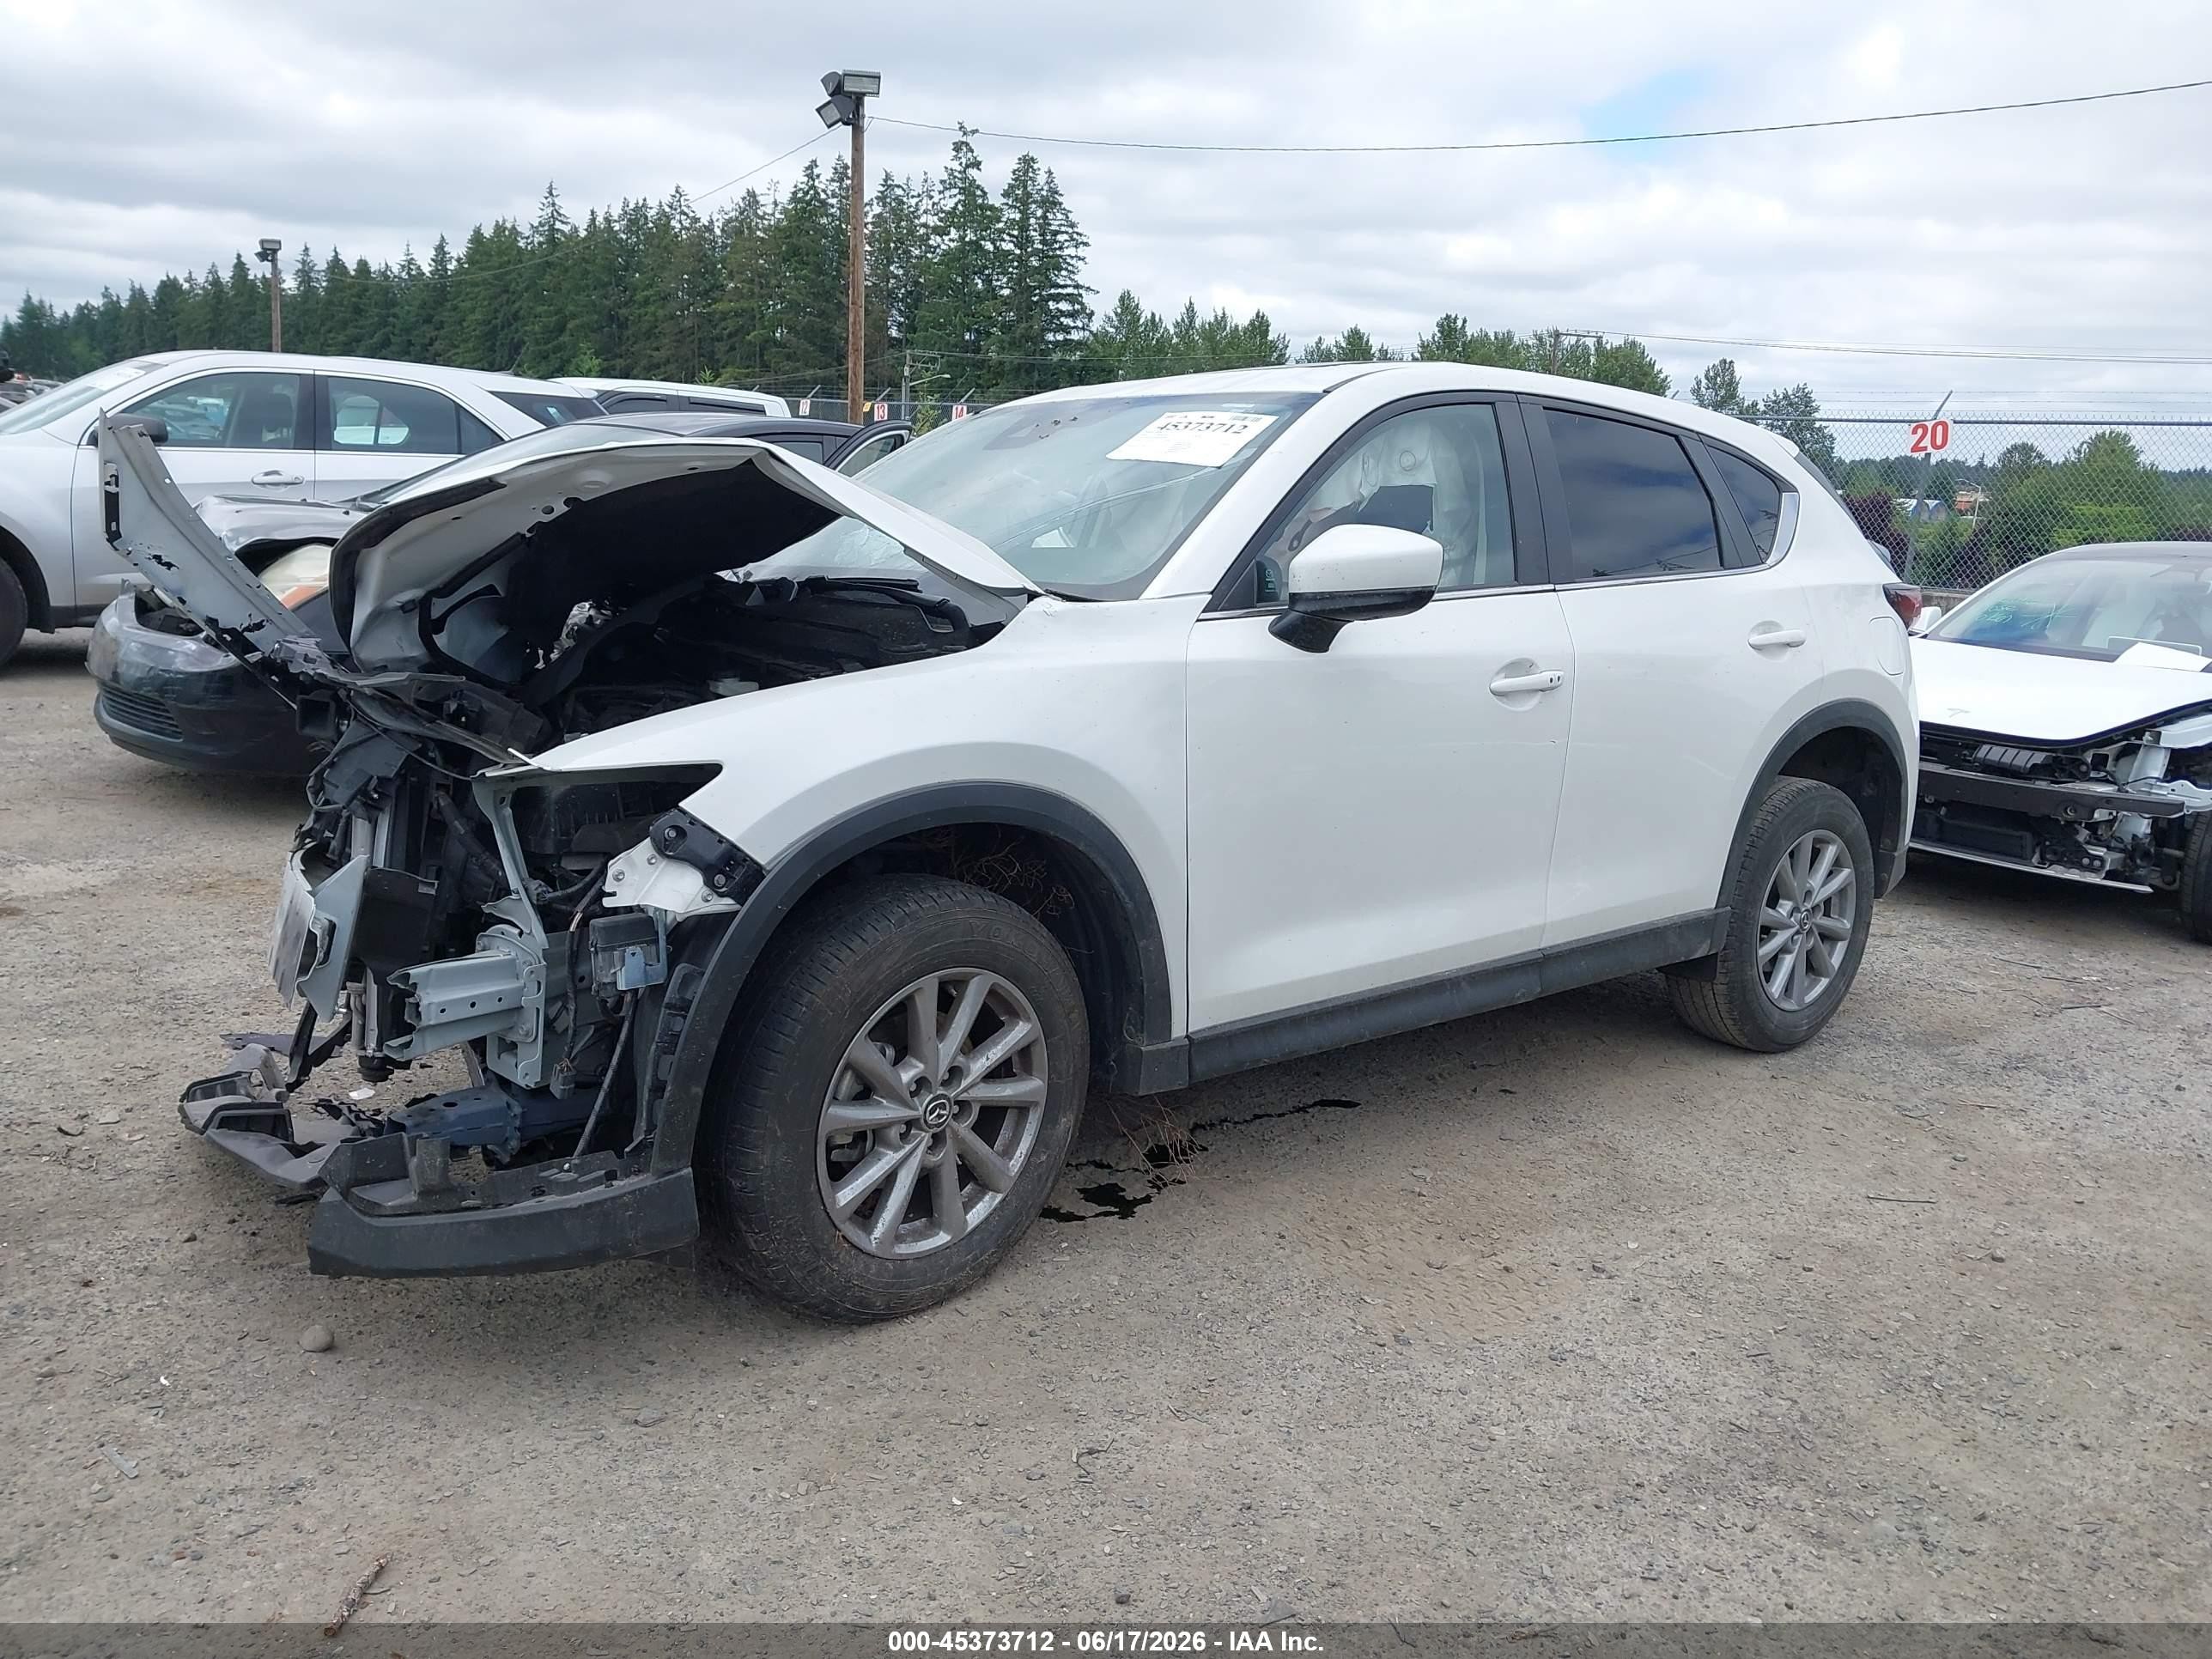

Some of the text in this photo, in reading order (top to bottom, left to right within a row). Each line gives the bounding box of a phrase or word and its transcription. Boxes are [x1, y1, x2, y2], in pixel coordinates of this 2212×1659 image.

[801, 400, 809, 415] 12
[877, 404, 886, 420] 13
[955, 405, 964, 420] 14
[1157, 421, 1249, 434] 45373712
[1910, 420, 1948, 453] 20
